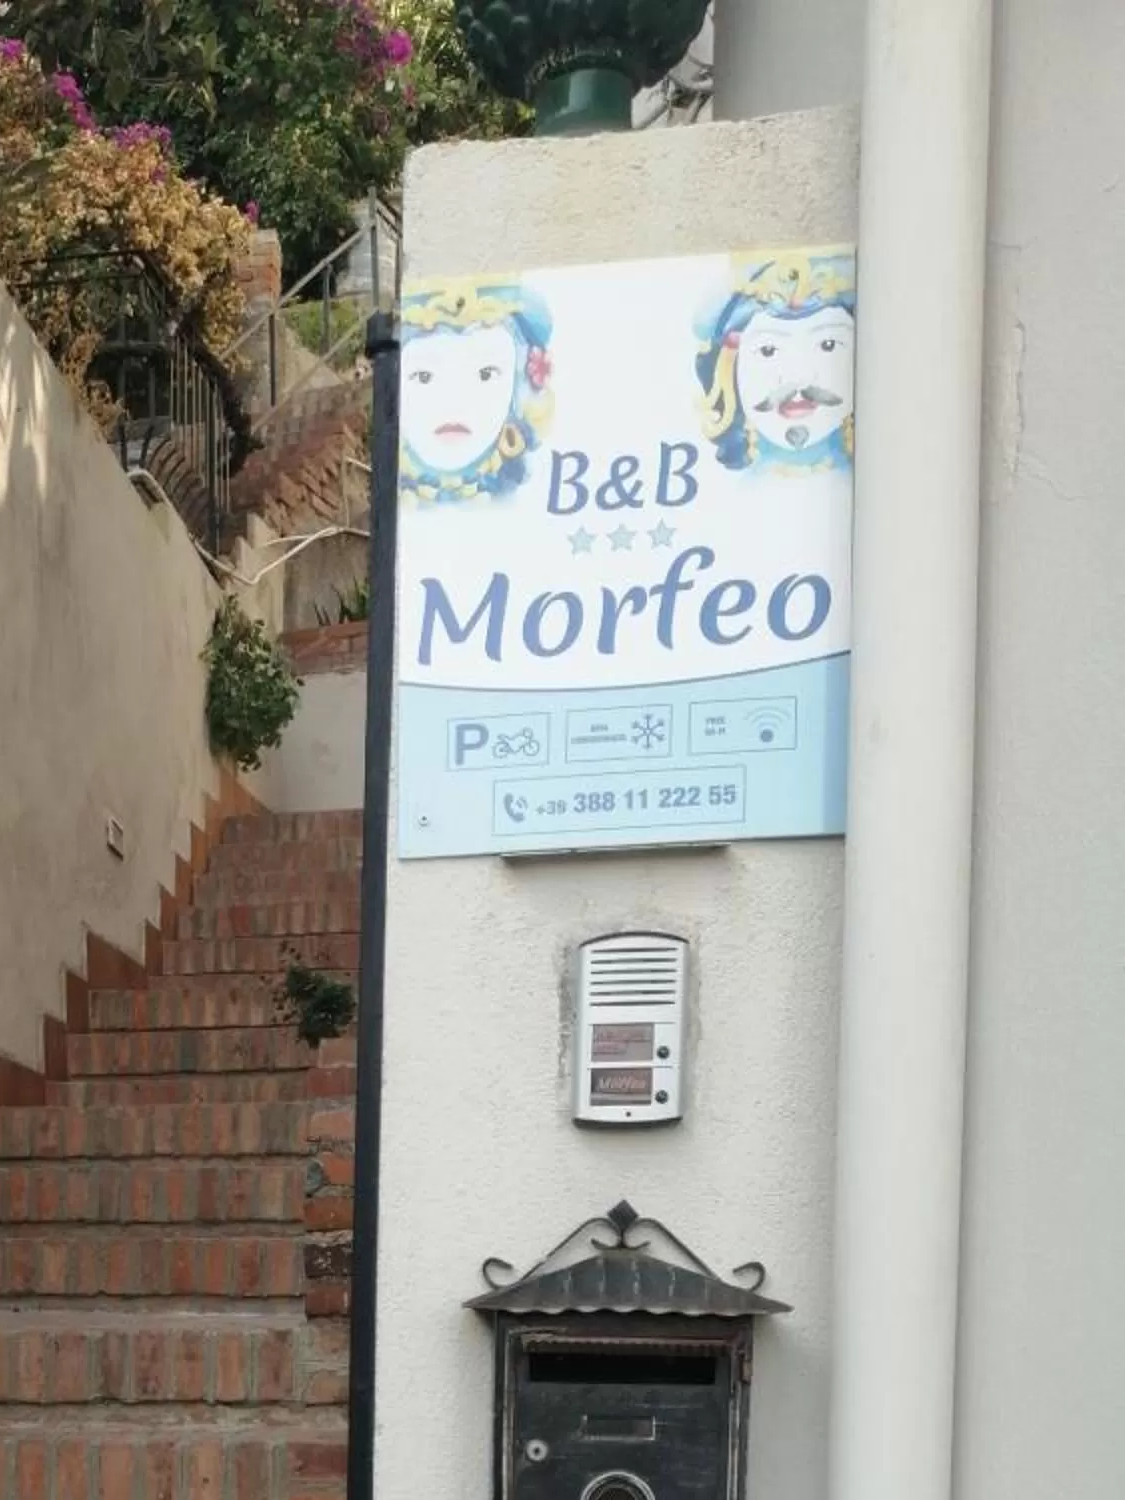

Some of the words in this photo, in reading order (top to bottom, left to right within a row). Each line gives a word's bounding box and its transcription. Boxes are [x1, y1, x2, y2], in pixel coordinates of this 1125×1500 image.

[546, 440, 699, 516] B&B
[417, 546, 832, 666] Morfeo
[455, 723, 489, 766] P
[536, 799, 567, 815] +39
[572, 791, 616, 814] 388
[623, 788, 649, 811] 11
[658, 785, 702, 809] 222
[708, 783, 737, 806] 55
